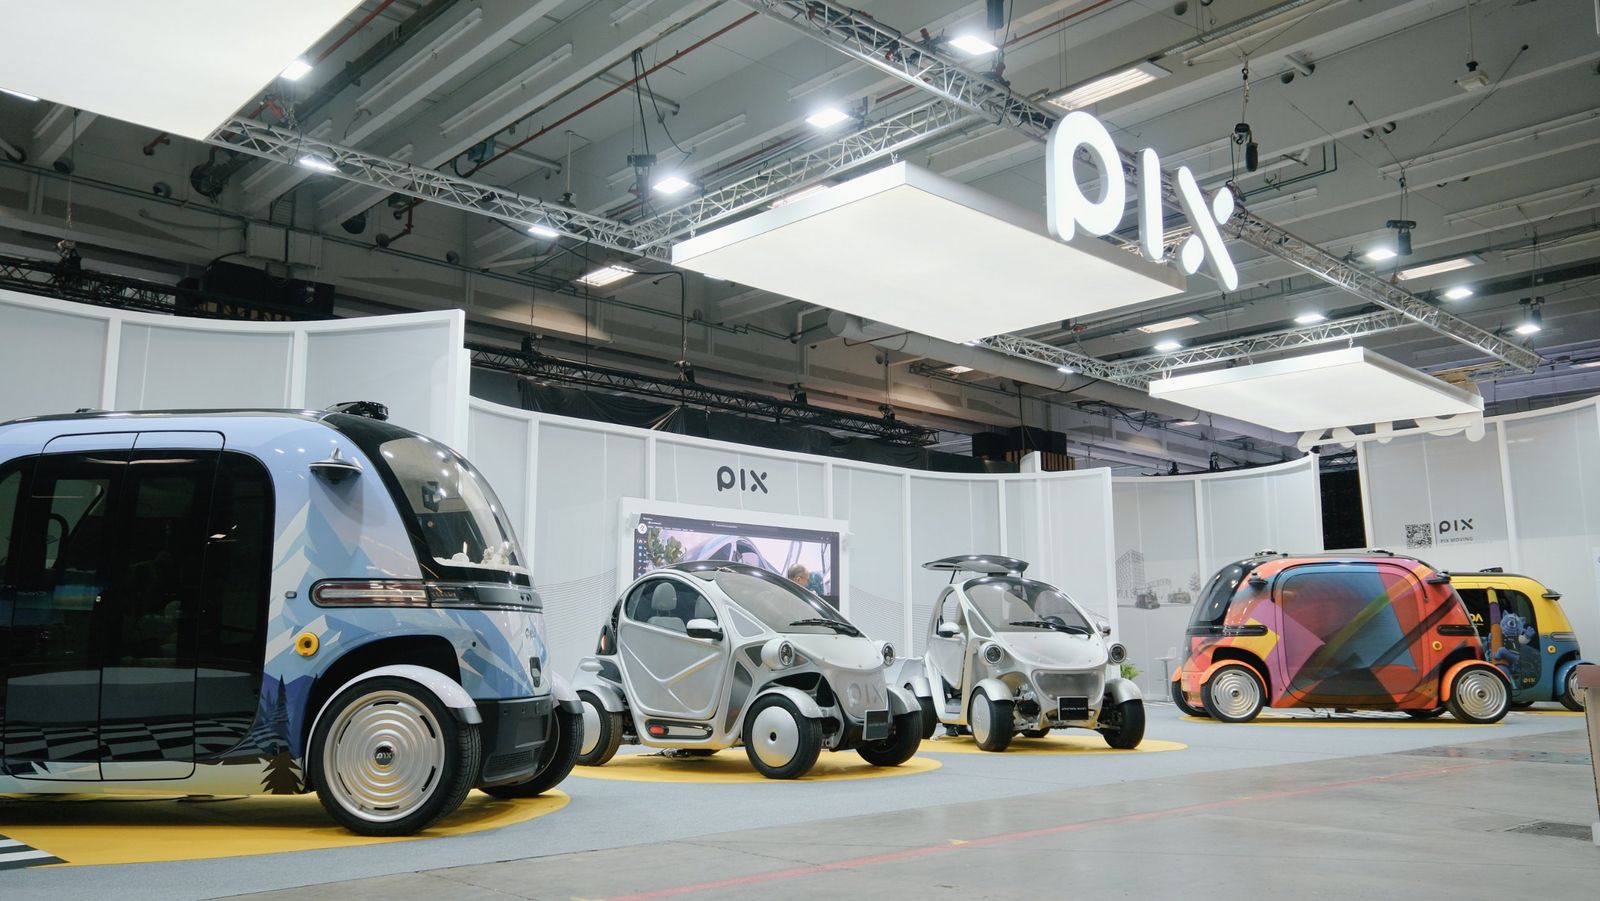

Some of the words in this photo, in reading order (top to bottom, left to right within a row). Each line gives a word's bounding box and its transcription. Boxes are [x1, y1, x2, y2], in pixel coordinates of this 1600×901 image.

[1047, 111, 1238, 291] PIX
[717, 466, 768, 494] PIX
[1439, 518, 1473, 534] PIX
